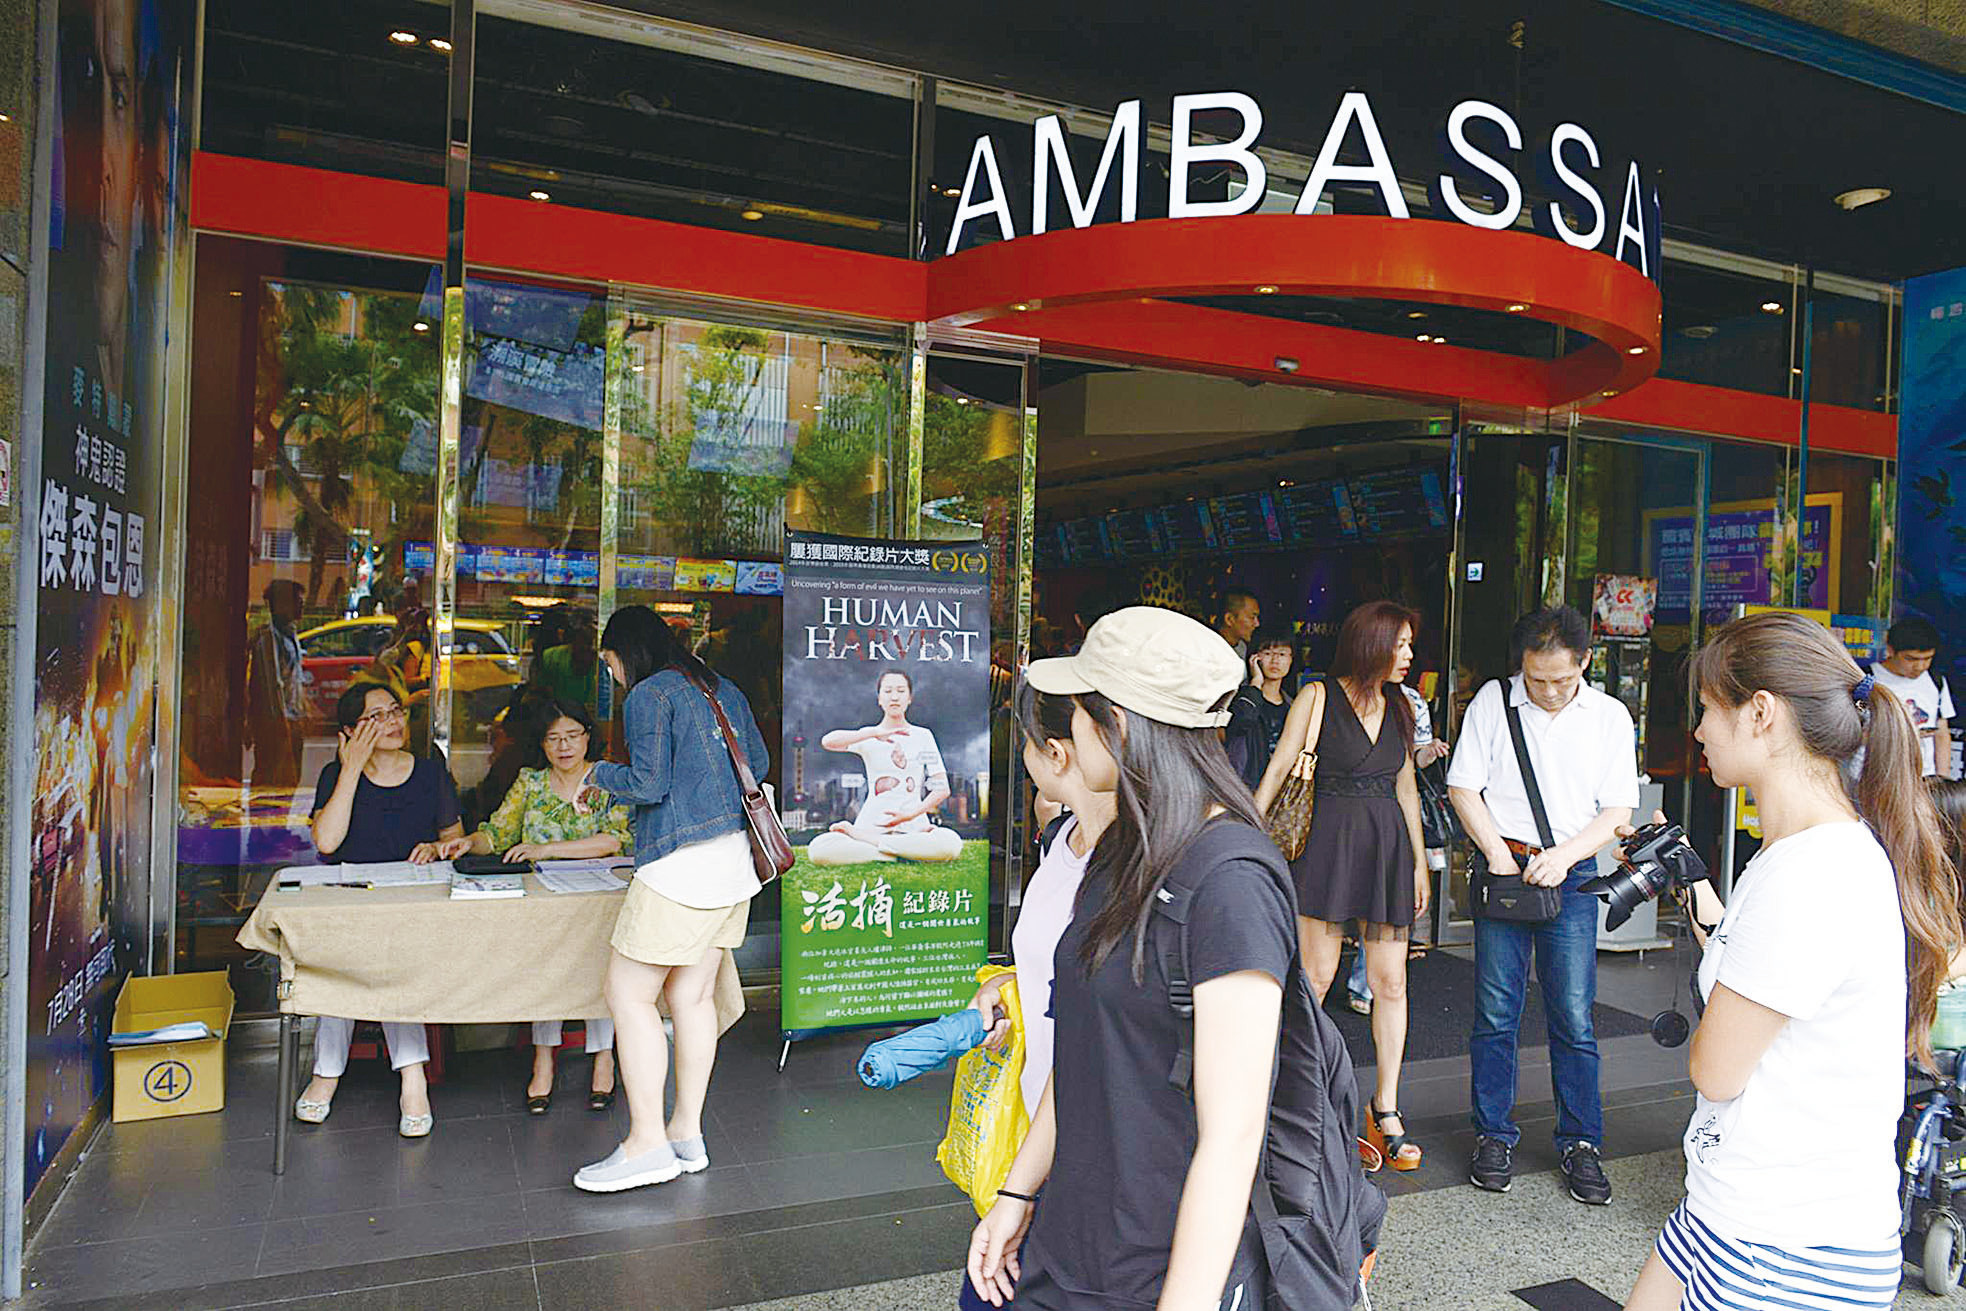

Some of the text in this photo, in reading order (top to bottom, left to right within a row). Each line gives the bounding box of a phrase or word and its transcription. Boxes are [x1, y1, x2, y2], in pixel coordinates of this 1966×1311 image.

[945, 91, 1649, 278] AMBASSA
[74, 424, 127, 494] 神鬼認證
[40, 478, 144, 598] 傑森包恩
[790, 542, 930, 566] 屢獲國際紀錄片大獎
[791, 579, 831, 590] Uncovering
[840, 581, 856, 590] form
[857, 582, 865, 590] of
[889, 584, 906, 592] have
[906, 585, 917, 594] yet
[918, 585, 925, 593] to
[821, 596, 963, 629] HUMAN
[804, 626, 980, 663] HARVEST
[801, 875, 973, 938] 活摘 紀錄片
[46, 969, 83, 1036] 7月28日
